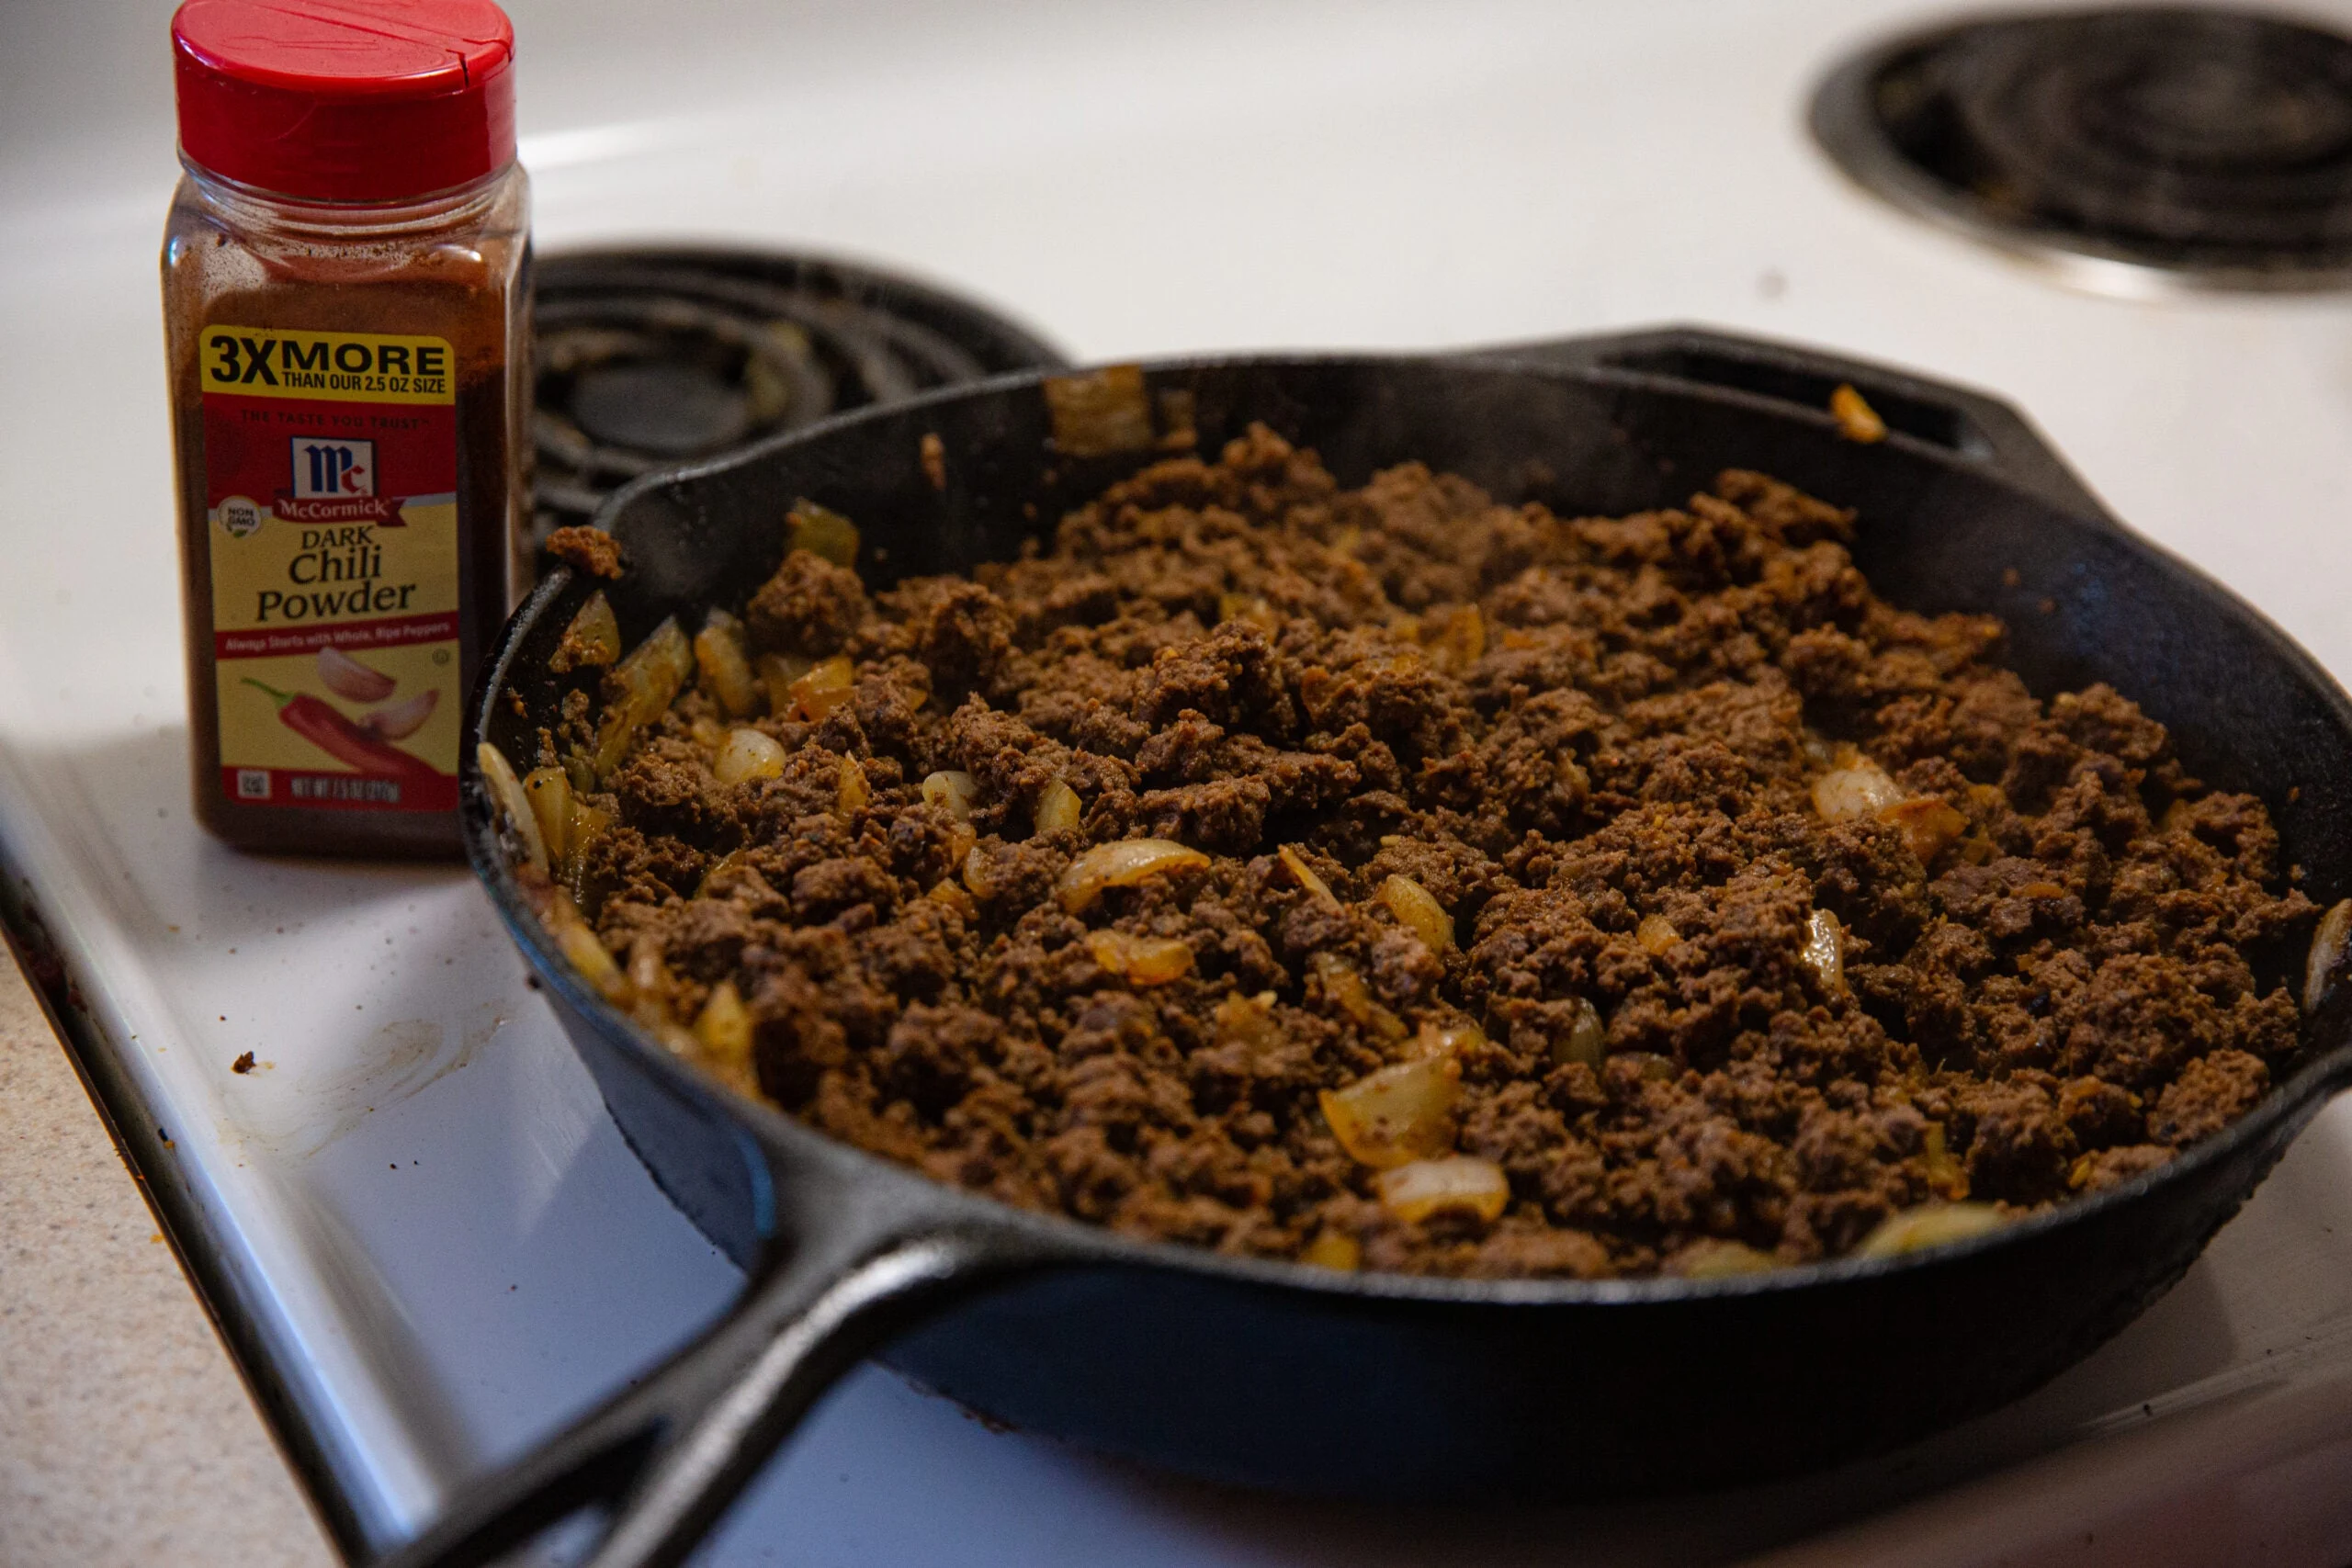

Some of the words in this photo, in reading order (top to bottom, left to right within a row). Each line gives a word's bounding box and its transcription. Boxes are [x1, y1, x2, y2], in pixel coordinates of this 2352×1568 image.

[210, 335, 278, 387] 3X
[281, 340, 446, 377] MORE
[282, 371, 325, 389] THAN
[329, 373, 362, 391] OUR
[365, 375, 386, 393] 2.5
[390, 377, 410, 393] OZ
[413, 378, 446, 394] SIZE
[241, 409, 270, 423] THE
[277, 412, 324, 427] TASTE
[331, 415, 364, 428] YOU
[228, 507, 254, 516] NON
[228, 515, 255, 526] GMO
[277, 498, 390, 520] McCormick
[301, 525, 375, 550] DARK
[288, 545, 382, 585] Chili
[255, 581, 417, 623] Powder
[225, 637, 266, 651] Always
[268, 635, 302, 649] Starts
[306, 632, 332, 646] with
[376, 627, 400, 640] Ripe
[403, 622, 450, 637] Peppers
